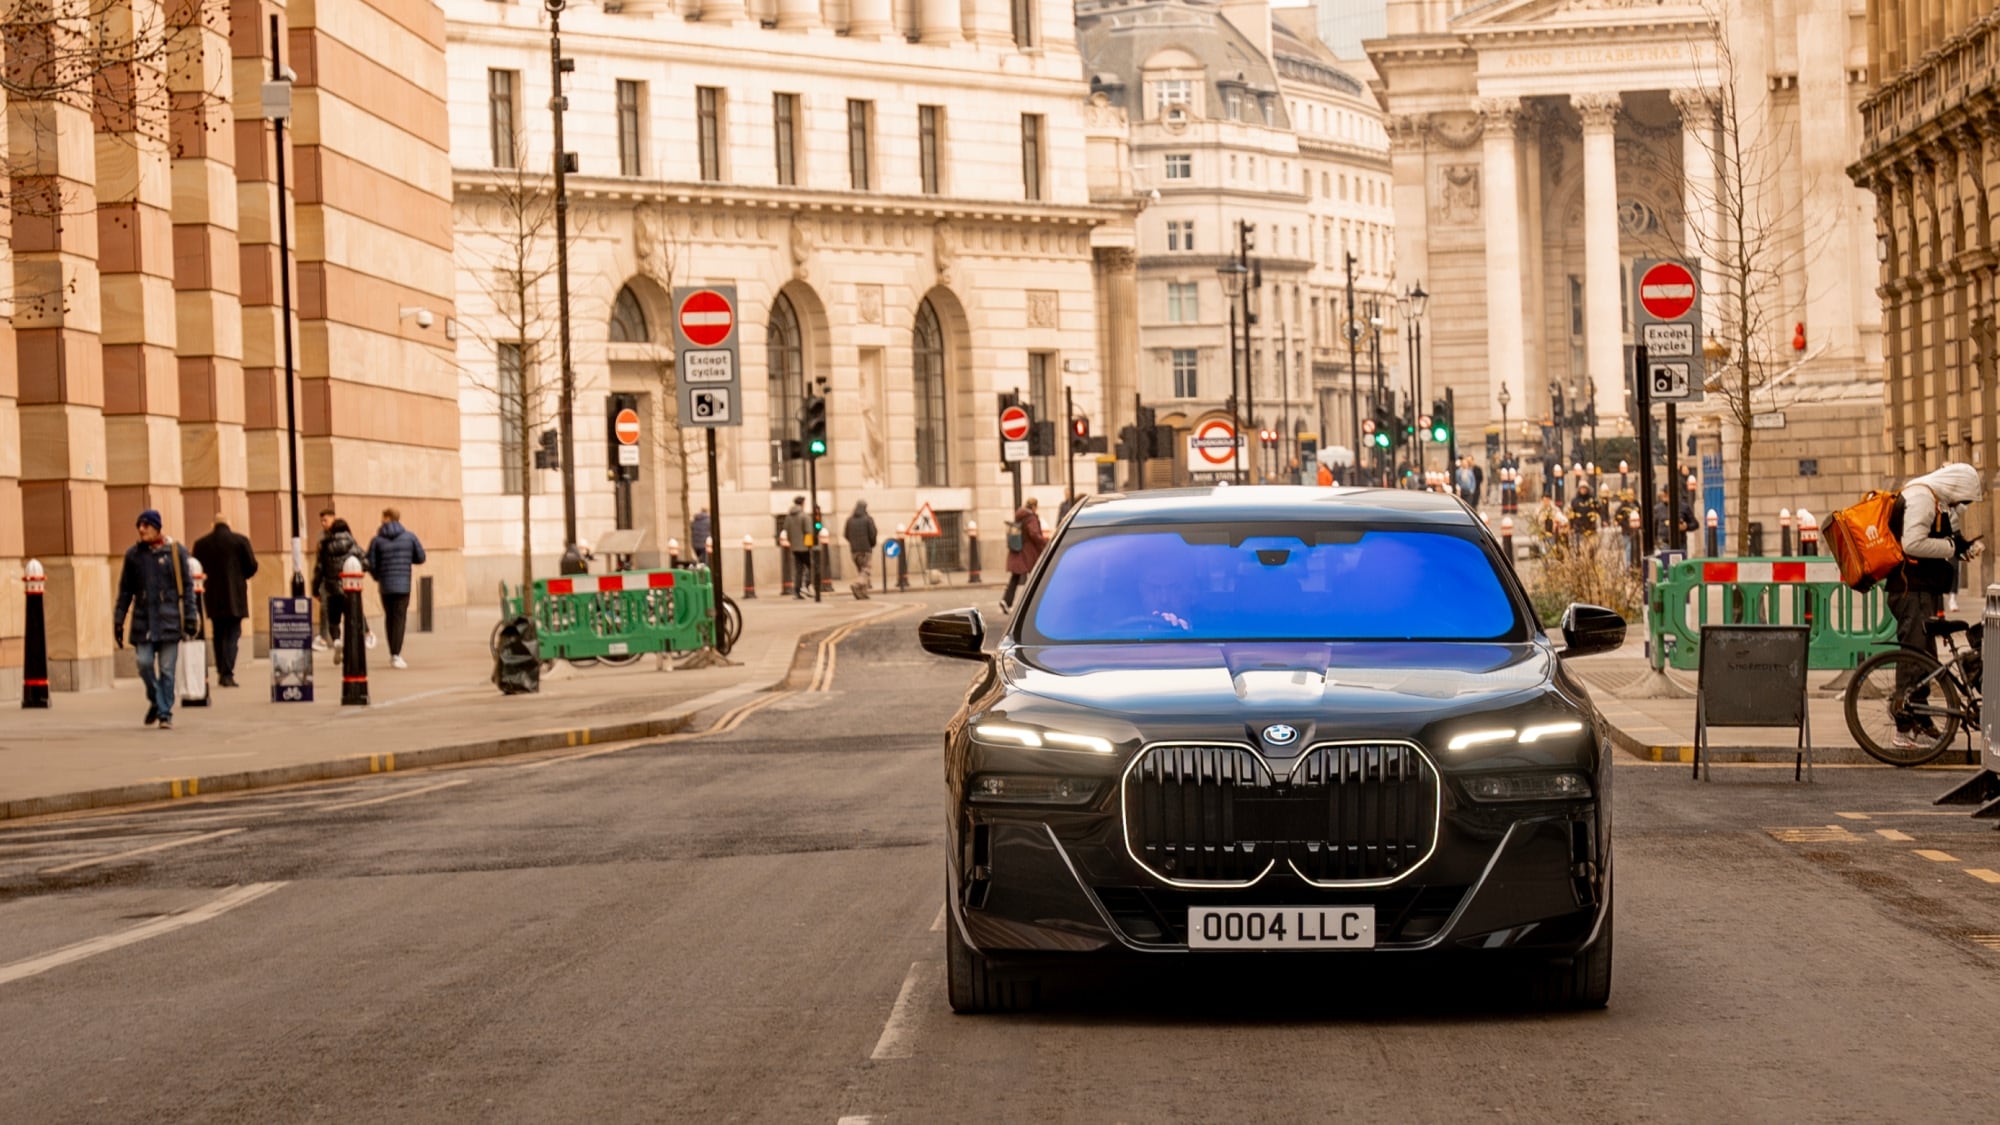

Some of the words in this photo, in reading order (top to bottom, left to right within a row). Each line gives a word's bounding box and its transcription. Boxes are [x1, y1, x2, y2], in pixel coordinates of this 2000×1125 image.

[1505, 53, 1550, 67] ANNO
[1564, 47, 1680, 65] ELIZABETHAE
[1649, 330, 1687, 339] Except
[1651, 341, 1686, 351] cycles
[690, 356, 727, 366] Except
[692, 368, 726, 377] cycles
[1192, 437, 1243, 447] UNDERGROUD
[1298, 912, 1359, 941] LLC
